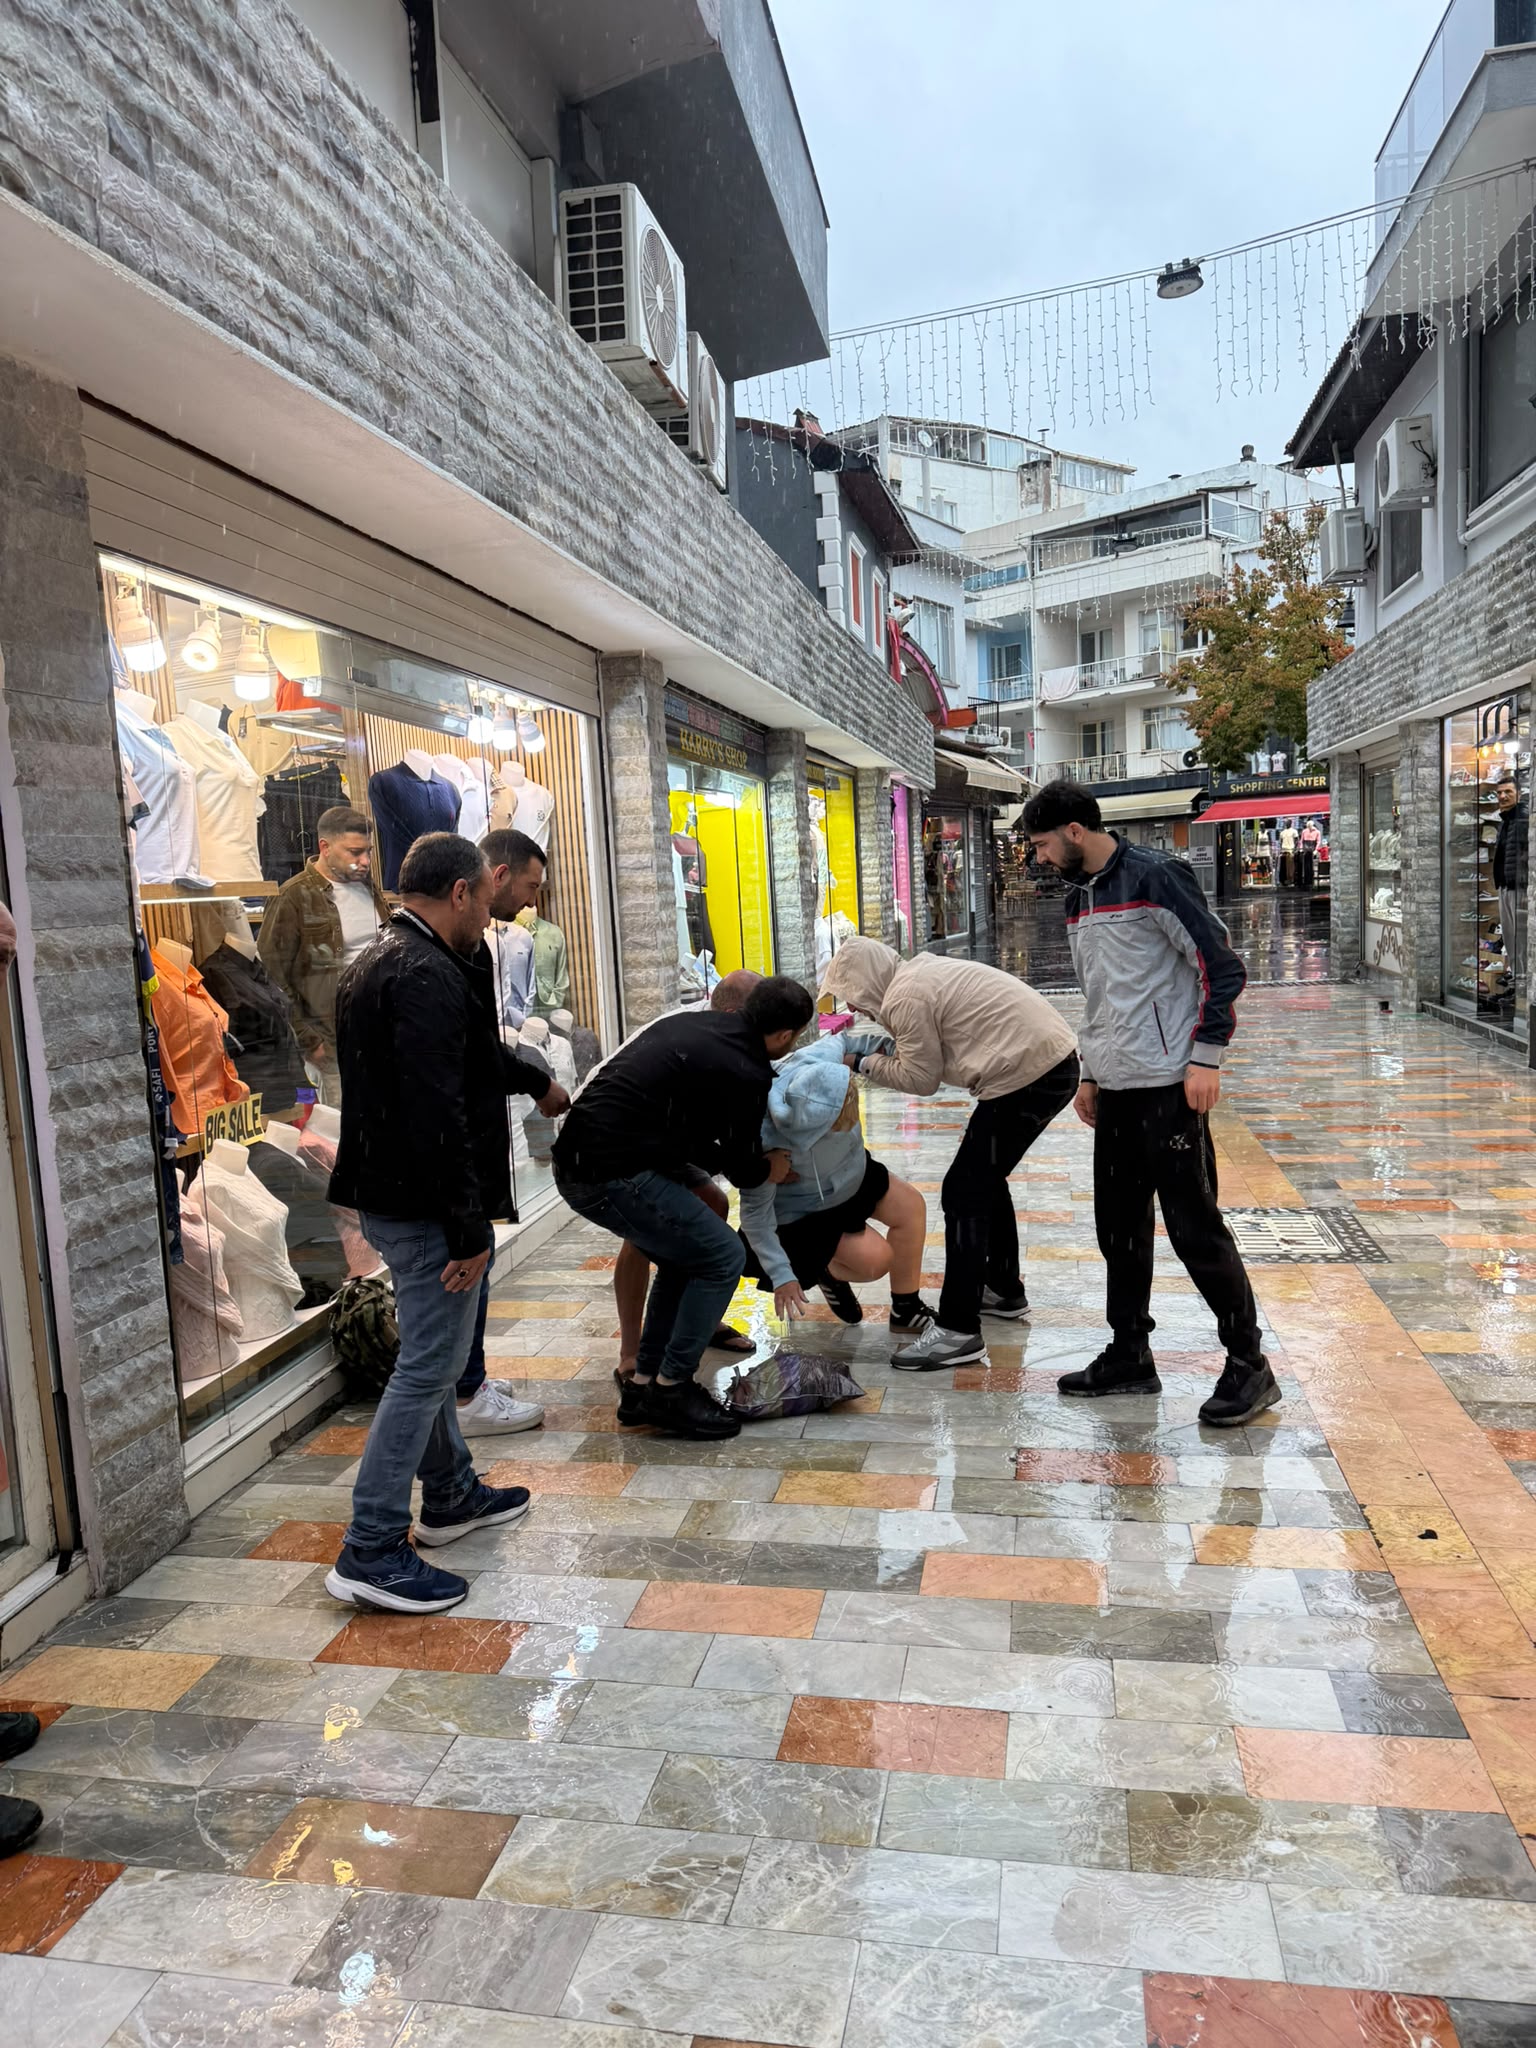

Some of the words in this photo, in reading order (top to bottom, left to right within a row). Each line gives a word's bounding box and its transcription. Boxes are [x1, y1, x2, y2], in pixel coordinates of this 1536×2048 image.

[680, 727, 725, 763] HARRY'S
[724, 745, 748, 769] SHOP
[1230, 780, 1284, 793] SHOPPING
[1286, 776, 1326, 789] CENTER
[205, 1110, 225, 1154] BIG
[228, 1099, 262, 1142] SALE
